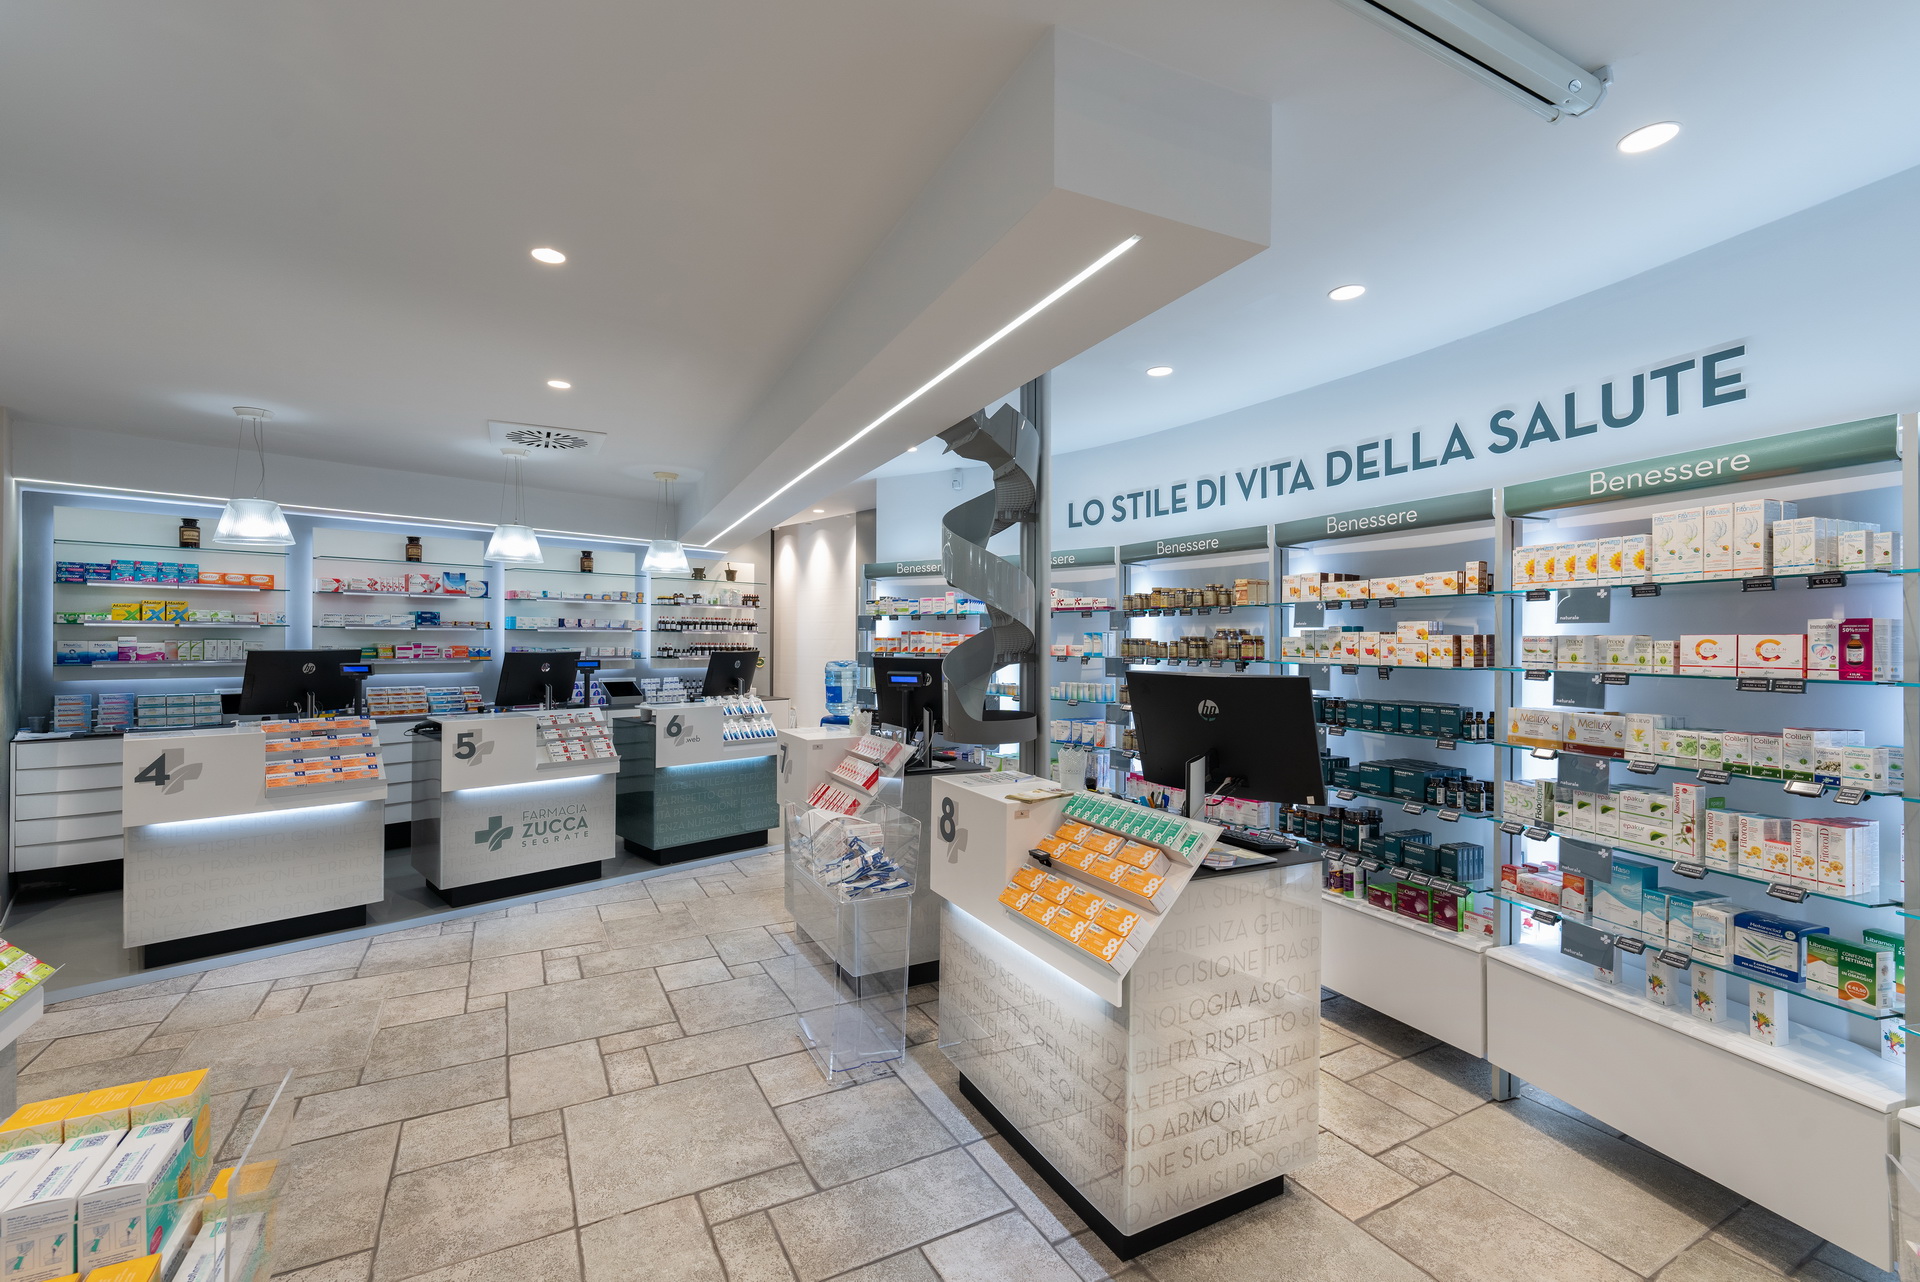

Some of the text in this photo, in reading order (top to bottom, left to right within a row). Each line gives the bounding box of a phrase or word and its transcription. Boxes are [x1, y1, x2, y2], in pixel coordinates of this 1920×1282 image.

[1068, 344, 1747, 529] LO STILE DI VITA DELLA SALUTE
[1589, 453, 1751, 496] Benessere
[1326, 508, 1418, 534] Benessere
[1156, 535, 1219, 556] Benessere
[666, 715, 683, 737] 6
[1577, 718, 1613, 731] MeliLAX
[1627, 716, 1651, 724] SOLLIEVO
[454, 732, 477, 760] 5
[685, 734, 701, 744] .web
[1724, 734, 1750, 743] Colilen
[1753, 737, 1780, 746] Colilen
[1784, 732, 1813, 741] Colilen
[1843, 750, 1872, 758] Calmansia
[134, 752, 171, 786] 4
[1560, 780, 1580, 788] naturale
[671, 790, 715, 805] RISPETTO
[717, 784, 770, 798] GENTILEZZA
[1535, 782, 1544, 820] Fisiodepur
[1623, 794, 1646, 803] epakur
[522, 803, 587, 822] FARMACIA
[673, 799, 739, 817] PREVENZIONE
[522, 815, 589, 838] ZUCCA
[687, 812, 743, 828] NUTRIZIONE
[939, 796, 956, 843] 8
[1622, 822, 1645, 831] epakur
[521, 829, 589, 848] SEGRATE
[663, 825, 739, 846] RIGENERAZIONE
[1561, 864, 1581, 873] naturale
[1865, 936, 1896, 948] Libramed
[1563, 947, 1584, 957] naturale
[1841, 951, 1873, 964] CONFEZIONE
[1844, 956, 1875, 969] SETTIMANE
[1133, 949, 1258, 997] PRECISIONE
[1847, 972, 1873, 983] OMAGGIO
[1205, 1011, 1297, 1056] RISPETTO
[1148, 1057, 1256, 1110] EFFICACIA
[1161, 1090, 1261, 1141] ARMONIA
[1181, 1113, 1290, 1169] SICUREZZA
[1148, 1167, 1230, 1223] ANALISI
